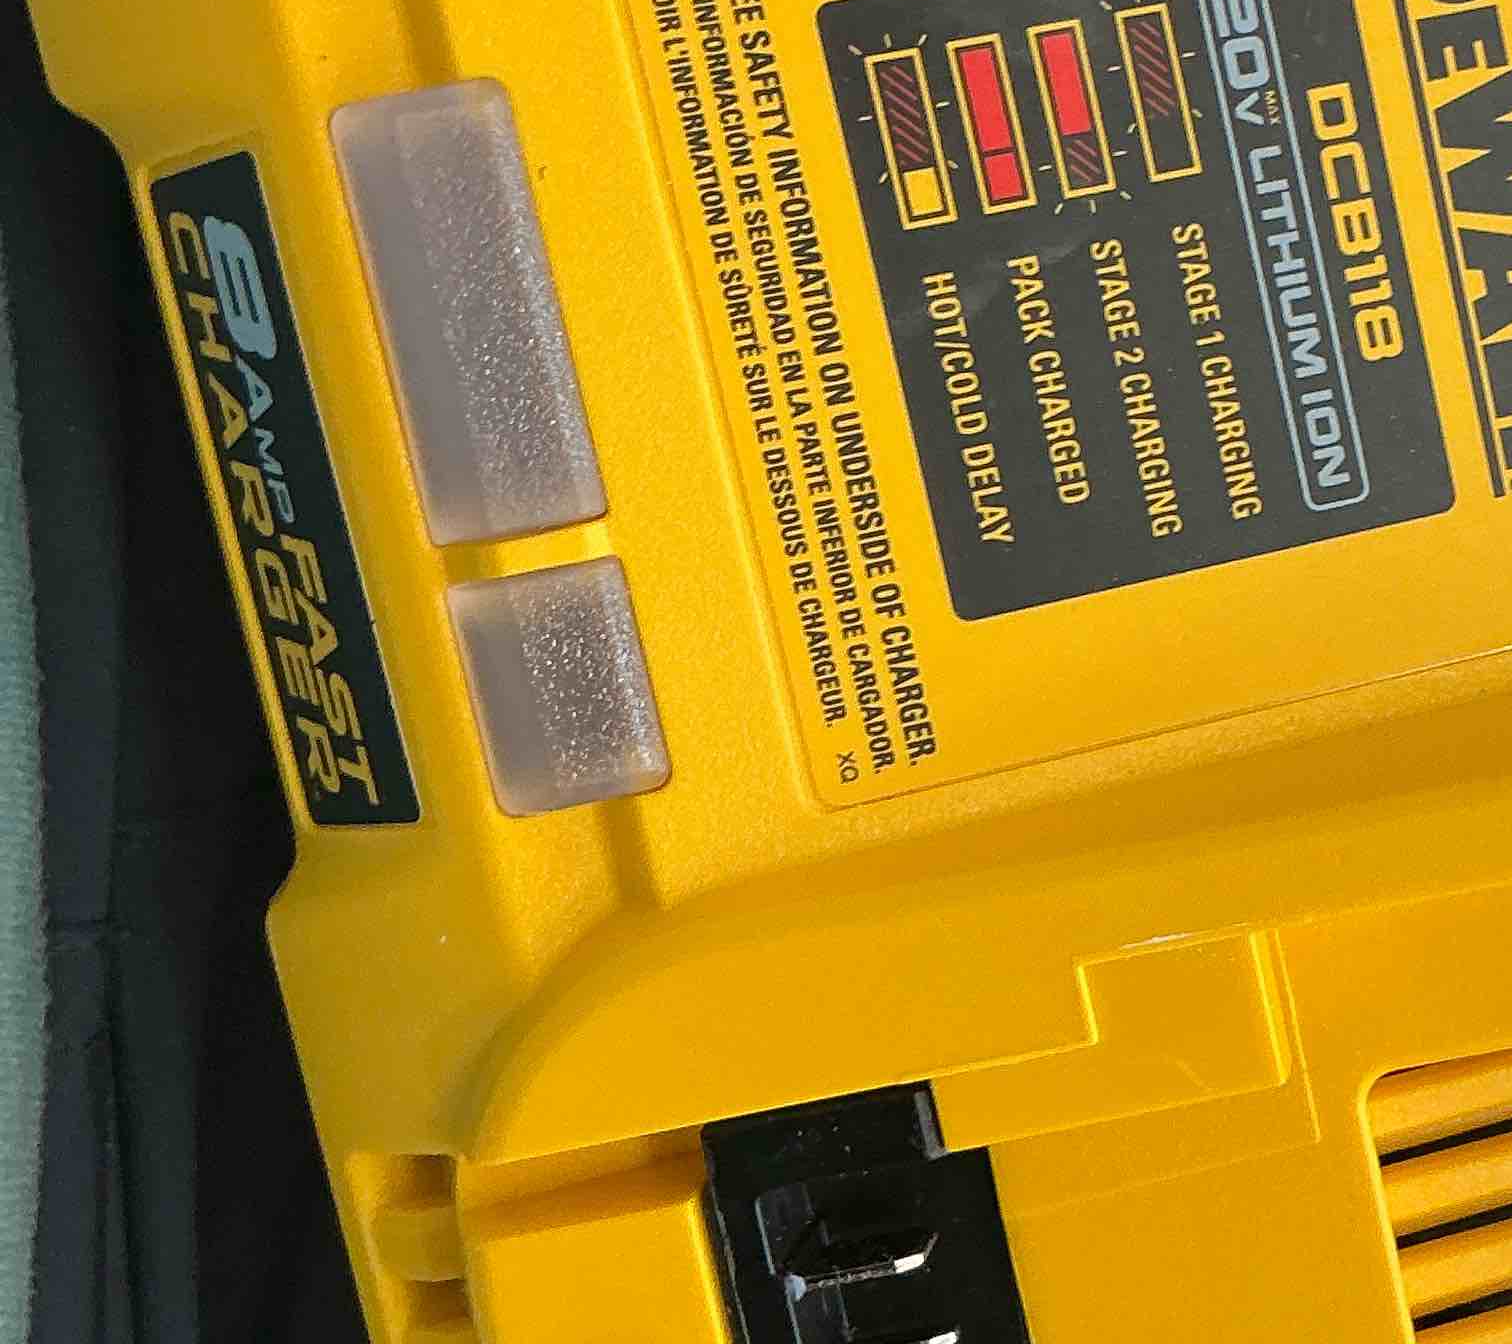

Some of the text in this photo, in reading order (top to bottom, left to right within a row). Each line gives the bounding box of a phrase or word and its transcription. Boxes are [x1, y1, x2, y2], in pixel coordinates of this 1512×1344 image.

[663, 37, 730, 226] L'INFORMATION
[740, 30, 794, 139] SAFETY
[710, 231, 739, 264] DE
[734, 173, 763, 206] DE
[1306, 82, 1404, 362] DCB118
[743, 209, 796, 345] SEGURIDAD
[767, 148, 843, 356] INFORMATION
[718, 268, 767, 359] SÛRETÉ
[777, 350, 805, 383] EN
[1171, 223, 1262, 520] STAGE 1 CHARGING
[1248, 144, 1329, 379] LITHIUM
[1300, 388, 1351, 488] ION
[742, 363, 773, 412] SUR
[755, 415, 781, 444] LE
[785, 387, 813, 418] LA
[819, 362, 855, 406] ON
[922, 272, 1014, 542] HOT/COLD DELAY
[1006, 255, 1090, 504] PACK CHARGED
[1089, 239, 1183, 537] STAGE 2 CHARGING
[169, 212, 341, 793] CHARGER
[203, 215, 380, 805] 8 AMP FAST
[762, 447, 808, 557] DESSOUS
[793, 422, 832, 495] PARTE
[831, 411, 896, 579] UNDERSIDE
[789, 561, 817, 594] DE
[812, 499, 857, 604] INFERIOR
[871, 583, 906, 618] OF
[798, 598, 848, 728] CHARGEUR.
[838, 607, 866, 640] DE
[847, 643, 896, 774] CARGADOR.
[881, 625, 936, 766] CHARGER.
